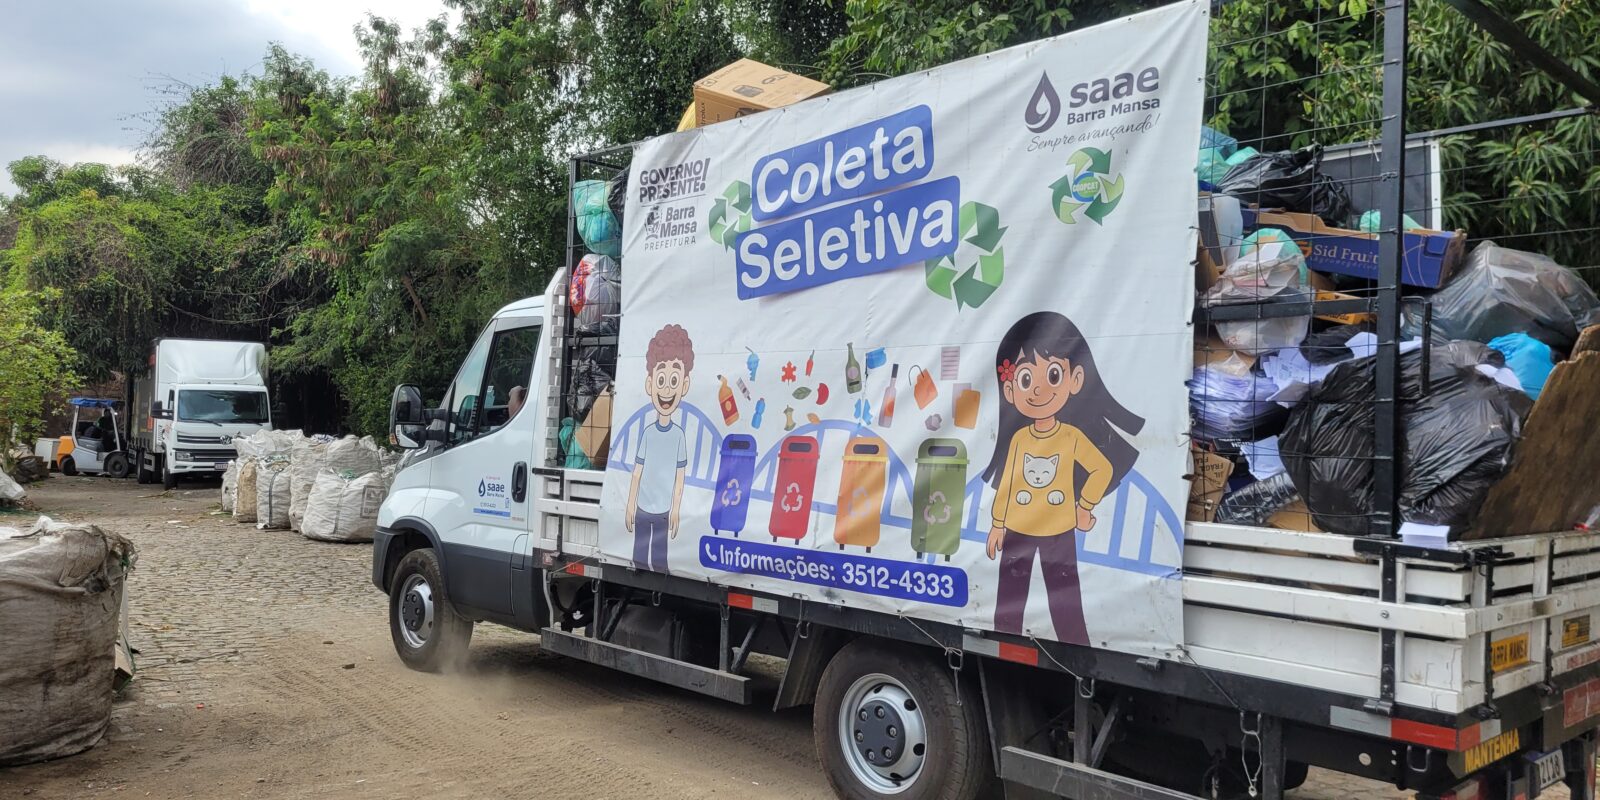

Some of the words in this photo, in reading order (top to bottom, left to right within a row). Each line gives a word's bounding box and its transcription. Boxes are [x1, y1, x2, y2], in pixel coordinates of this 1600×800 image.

[1069, 67, 1159, 108] saae
[1067, 109, 1106, 126] Barra
[1110, 98, 1161, 117] Mansa
[1027, 135, 1077, 152] Sempre
[1077, 113, 1161, 141] avançando!
[640, 160, 703, 186] GOVERNO
[756, 126, 926, 214] Coleta
[666, 206, 696, 222] Barra
[659, 221, 698, 239] Mansa
[644, 236, 697, 252] PREFEITURA
[740, 200, 953, 288] Seletiva
[1313, 244, 1338, 258] Sid
[487, 483, 505, 493] saae
[719, 543, 836, 580] Informações:
[842, 562, 954, 599] 3512-4333
[1491, 643, 1508, 666] ARRA
[1464, 728, 1520, 774] MANTENHA
